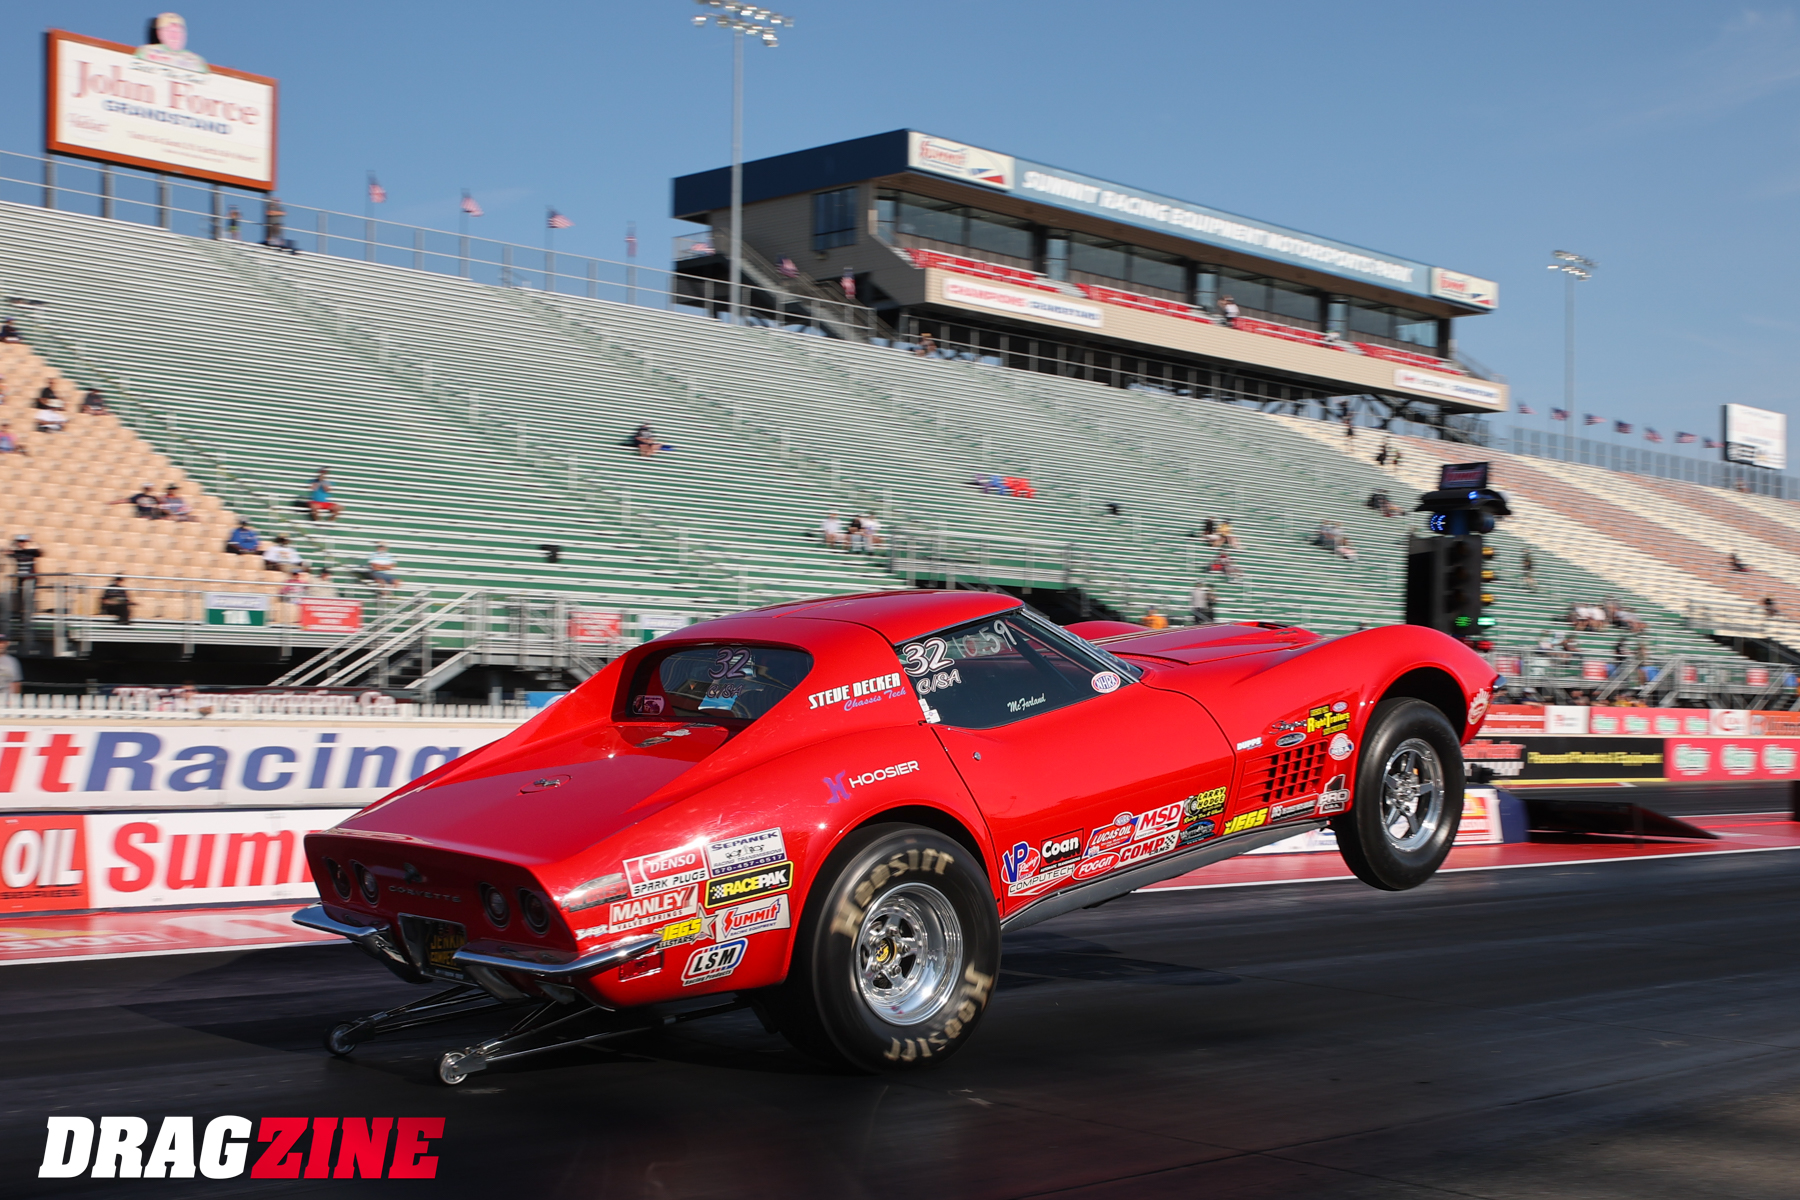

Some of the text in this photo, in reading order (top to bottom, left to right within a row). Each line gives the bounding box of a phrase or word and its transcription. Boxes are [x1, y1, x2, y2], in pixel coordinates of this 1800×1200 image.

[708, 646, 752, 679] 32
[902, 636, 955, 677] 32
[808, 672, 901, 710] STEVE DECKER
[1095, 674, 1118, 690] NHRA
[843, 686, 907, 712] Chassis Tech
[848, 760, 920, 788] HOOSIER
[1141, 804, 1181, 831] MSD
[1223, 808, 1268, 835] JEGS
[711, 831, 779, 852] SEPANEK
[1041, 837, 1080, 859] Coan
[1091, 828, 1119, 846] LUCAS
[1119, 824, 1133, 838] OIL
[2, 829, 84, 889] OIL
[104, 822, 320, 892] Sum
[1003, 842, 1029, 883] VP
[1121, 836, 1166, 863] COMP
[649, 853, 697, 874] DENSO
[714, 854, 784, 875] 570-457-6517
[1078, 855, 1115, 876] FOGGIT
[633, 878, 669, 895] SPARK
[672, 869, 706, 886] PLUGS
[722, 869, 789, 897] RACEPAK
[1009, 866, 1075, 893] COMPUTECH
[612, 889, 688, 923] MANLEY
[617, 909, 684, 931] VALVE SPRINGS
[693, 947, 737, 974] LSM
